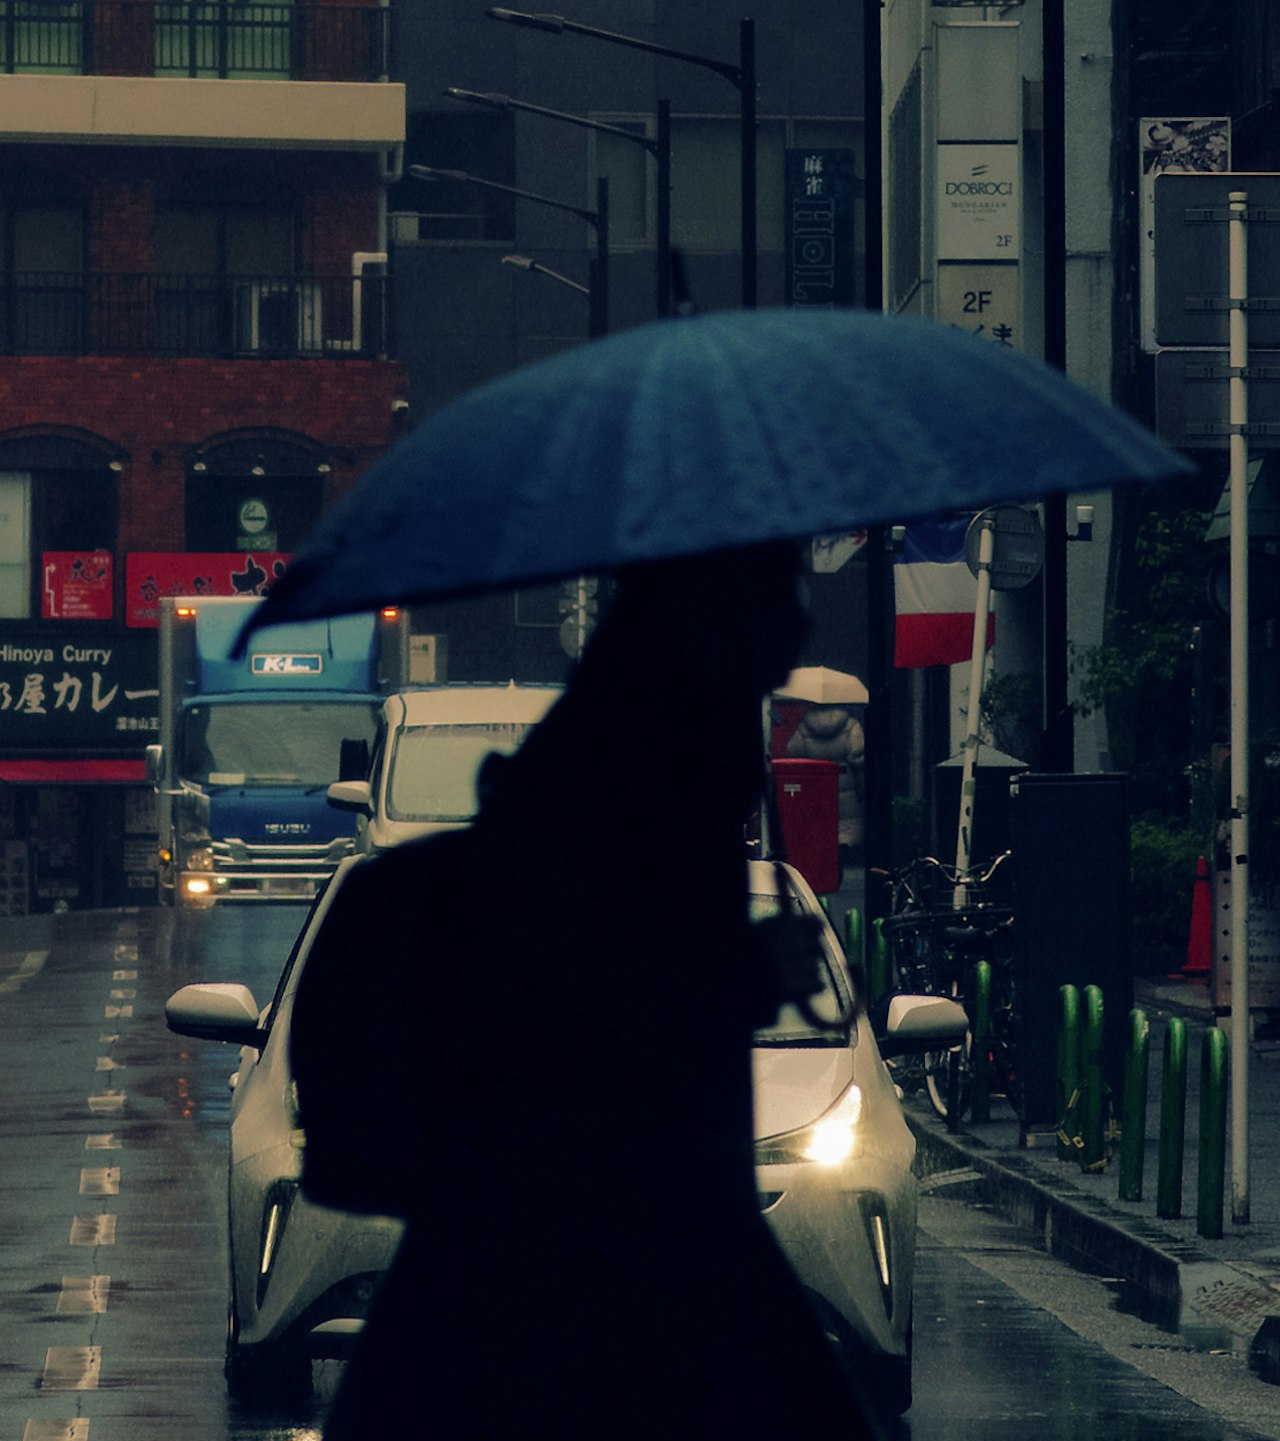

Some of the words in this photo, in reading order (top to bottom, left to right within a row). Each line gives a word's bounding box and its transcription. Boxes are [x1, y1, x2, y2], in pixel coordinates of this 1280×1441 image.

[995, 234, 1013, 247] 2F
[963, 290, 993, 313] 2F
[62, 644, 113, 666] Curry
[264, 823, 312, 835] ISUZU
